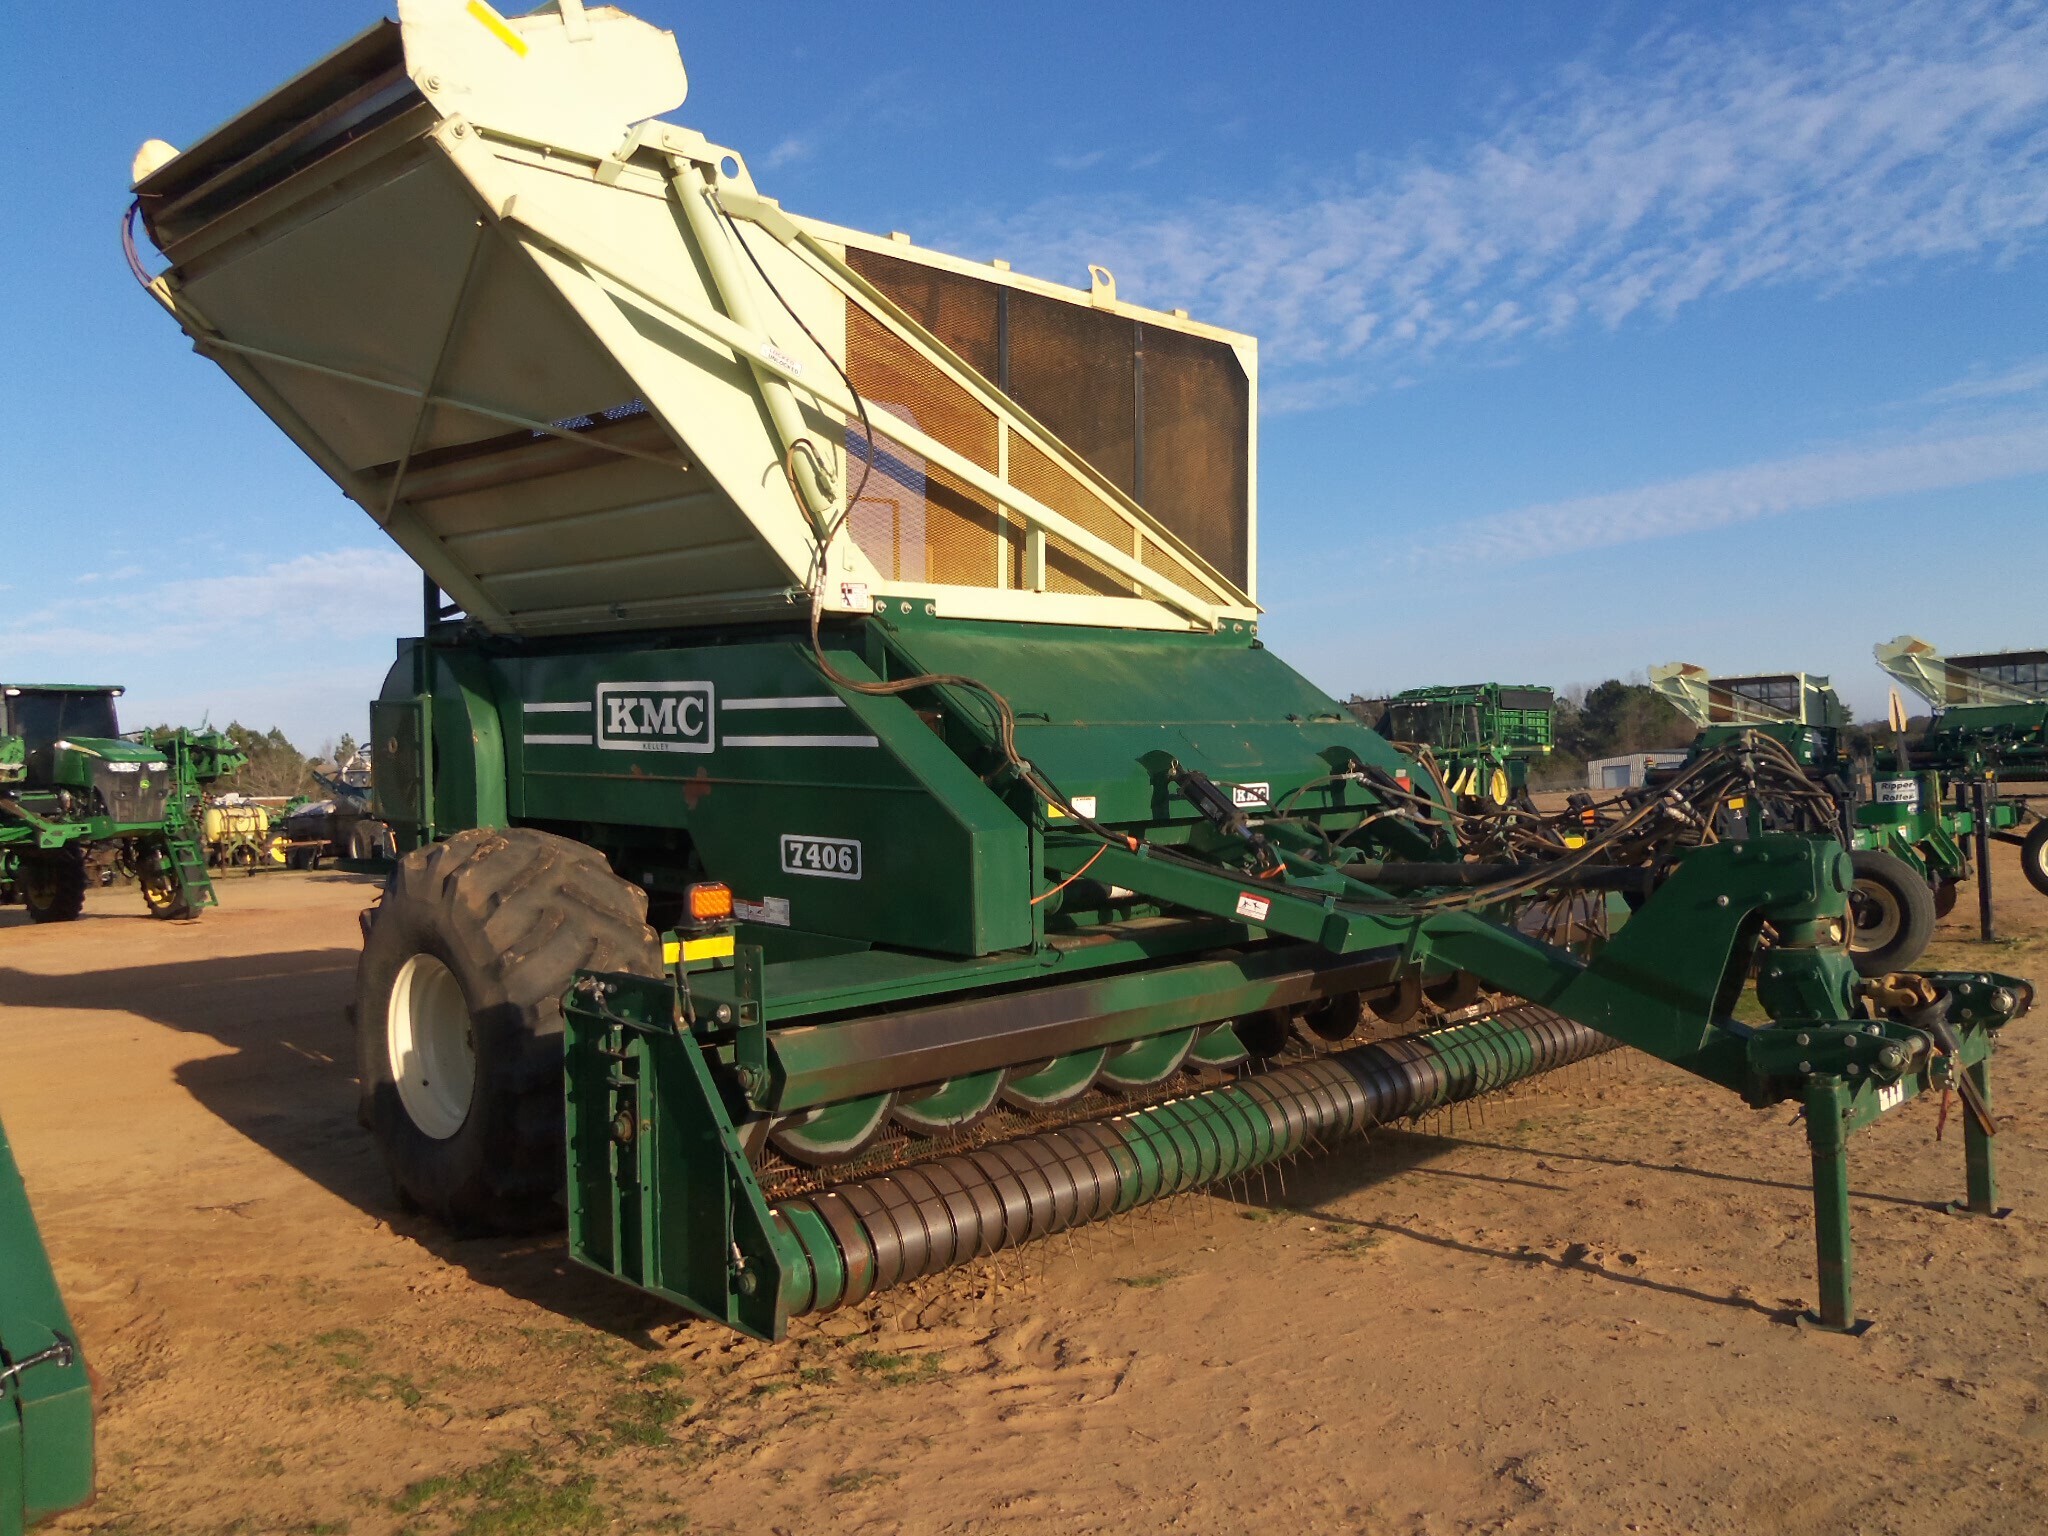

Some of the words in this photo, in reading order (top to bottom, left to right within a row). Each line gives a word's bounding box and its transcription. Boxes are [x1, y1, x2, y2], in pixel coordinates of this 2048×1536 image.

[607, 697, 704, 737] KMC
[642, 742, 669, 751] KELLEY
[1236, 787, 1267, 802] KMC
[1882, 793, 1915, 802] Roller
[789, 842, 853, 872] 7406
